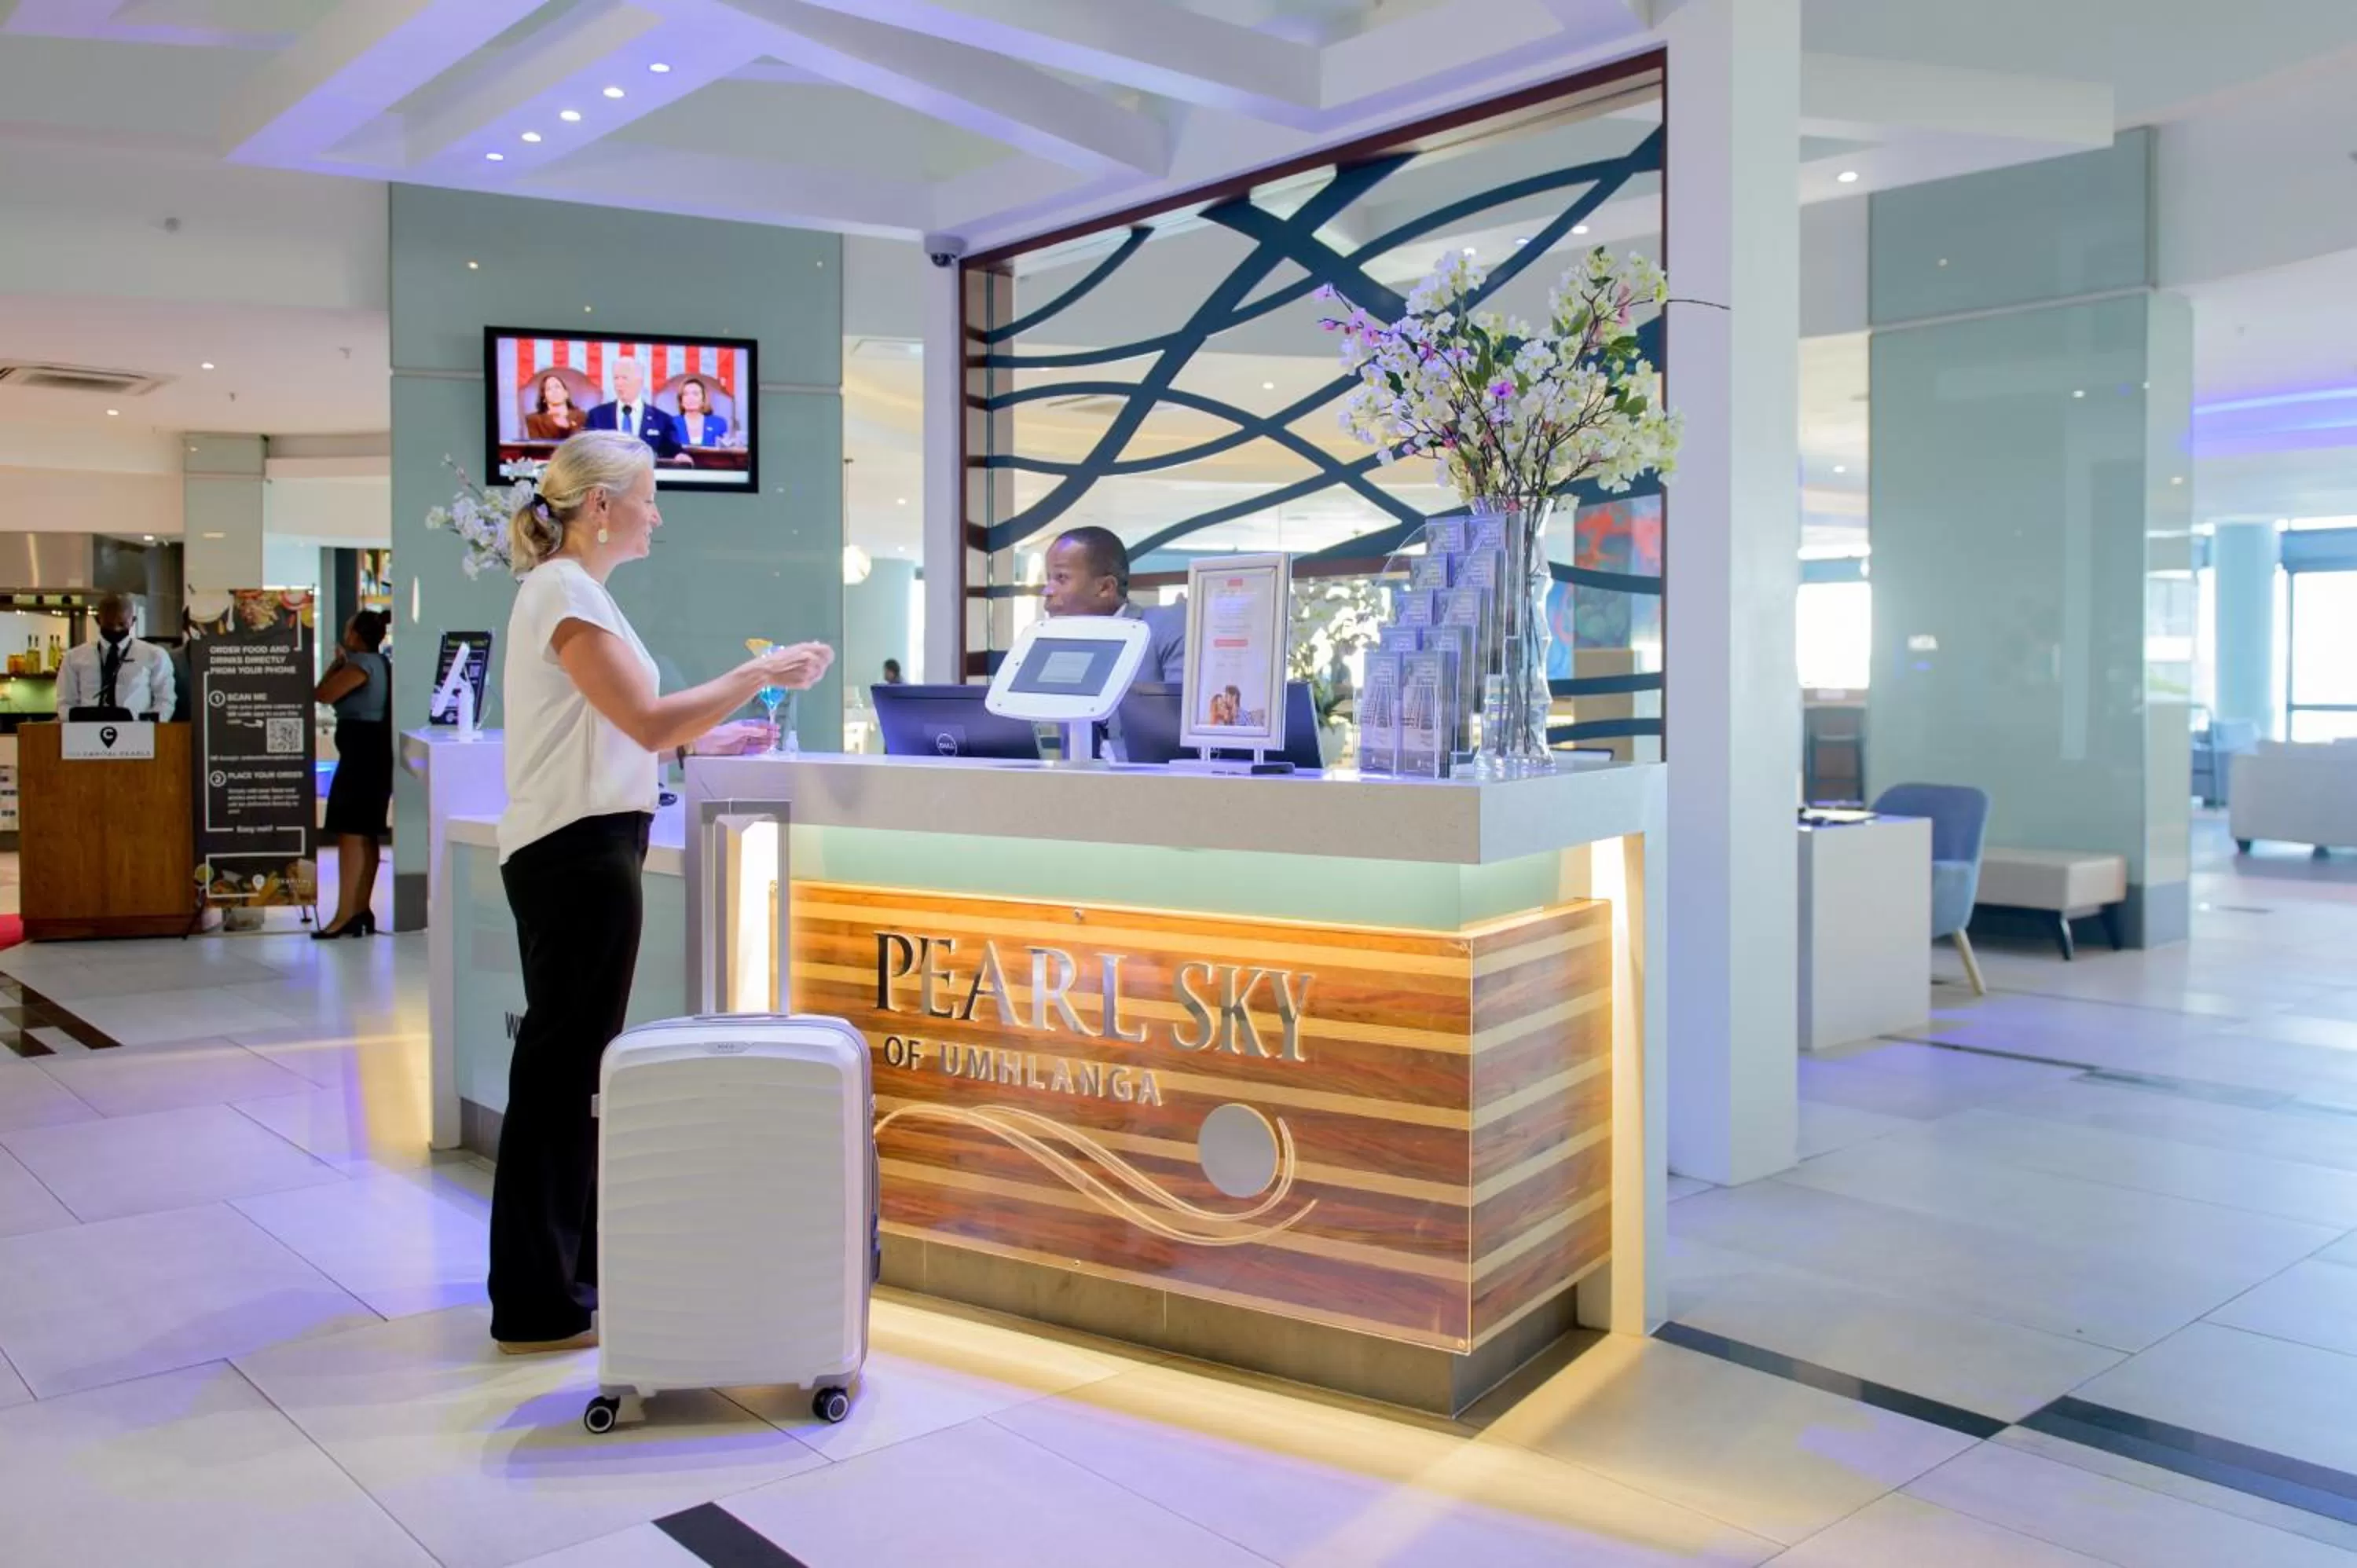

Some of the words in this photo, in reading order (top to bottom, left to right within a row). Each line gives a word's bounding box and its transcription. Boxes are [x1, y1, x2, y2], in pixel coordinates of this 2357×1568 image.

[873, 930, 1147, 1043] PEARL
[1170, 961, 1317, 1063] SKY
[884, 1035, 924, 1071] OF
[940, 1043, 1163, 1107] UMHLANGA
